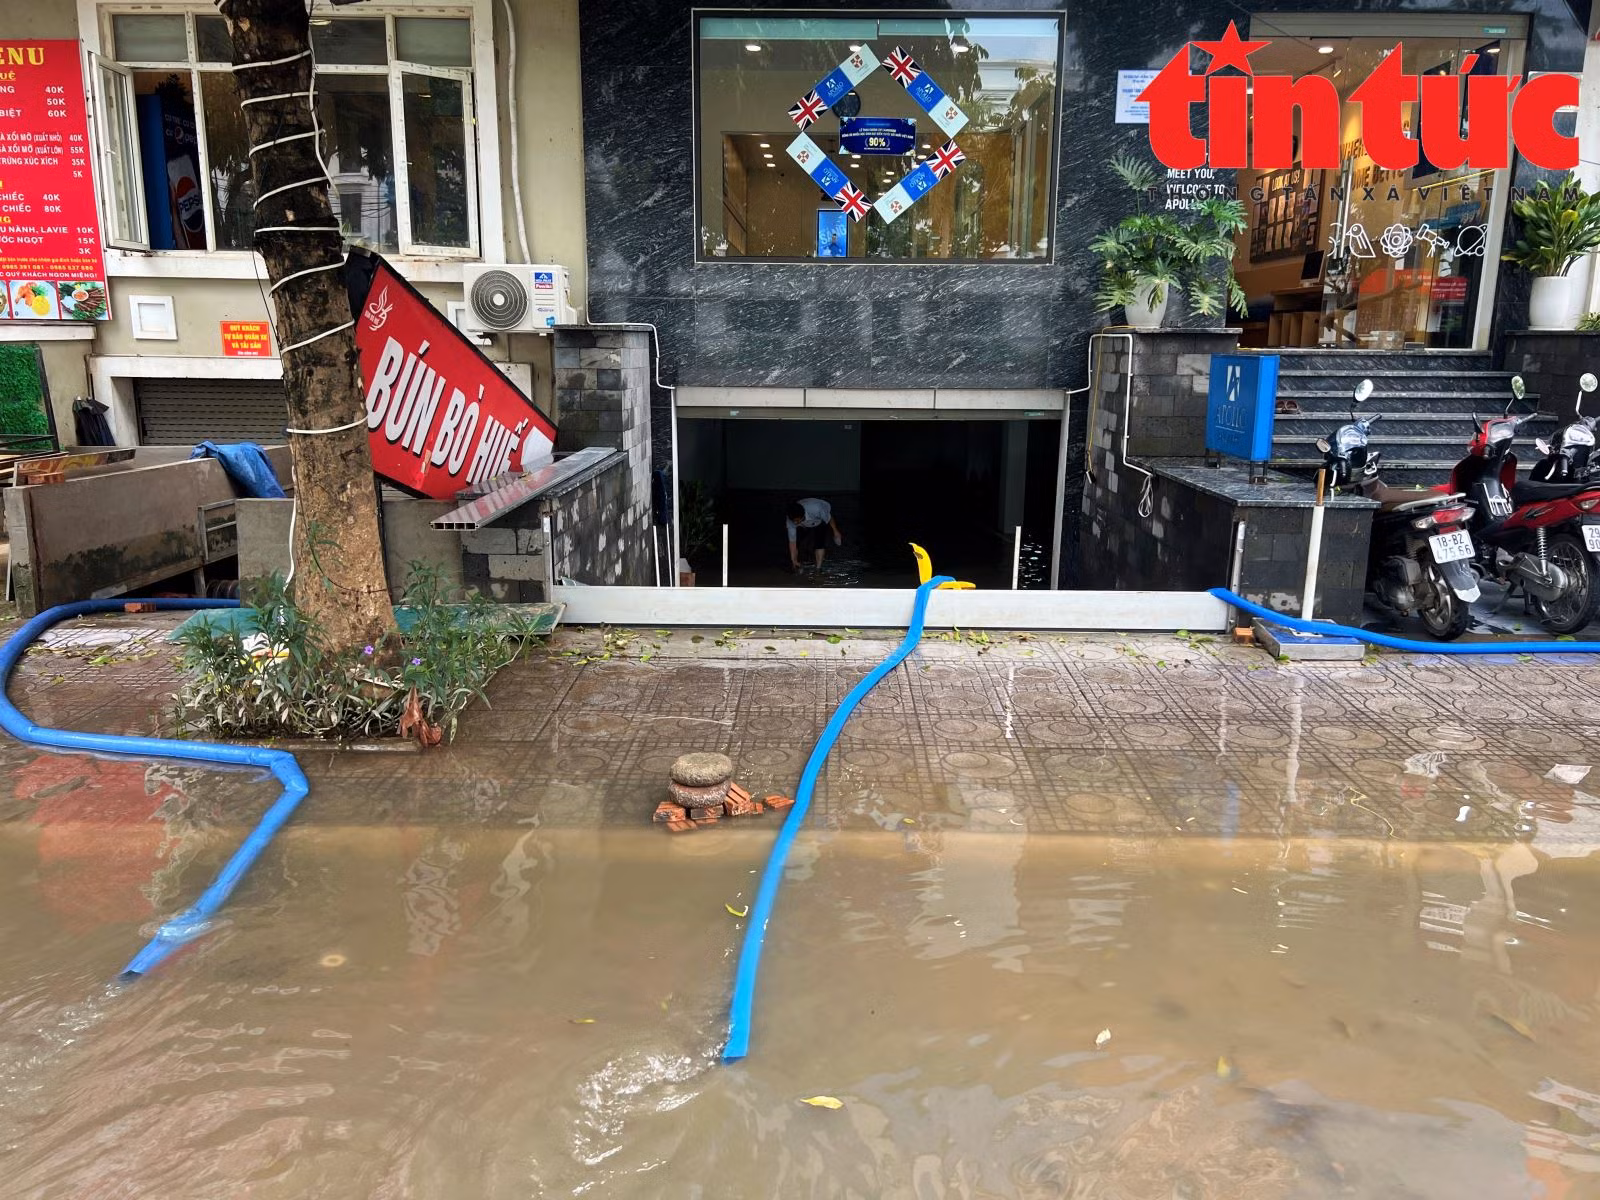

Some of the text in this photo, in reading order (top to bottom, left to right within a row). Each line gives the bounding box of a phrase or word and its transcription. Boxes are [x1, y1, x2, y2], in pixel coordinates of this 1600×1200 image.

[45, 86, 64, 94] 40K
[46, 98, 66, 106] 50K
[48, 110, 67, 118] 60K
[869, 137, 886, 147] 90%
[71, 158, 86, 166] 35K
[73, 170, 83, 178] 5K
[1167, 168, 1215, 179] MEET YOU,
[0, 191, 60, 201] HIẾC 40K
[44, 205, 61, 213] 80K
[40, 226, 68, 234] LAVIE
[366, 335, 447, 456] BÚN
